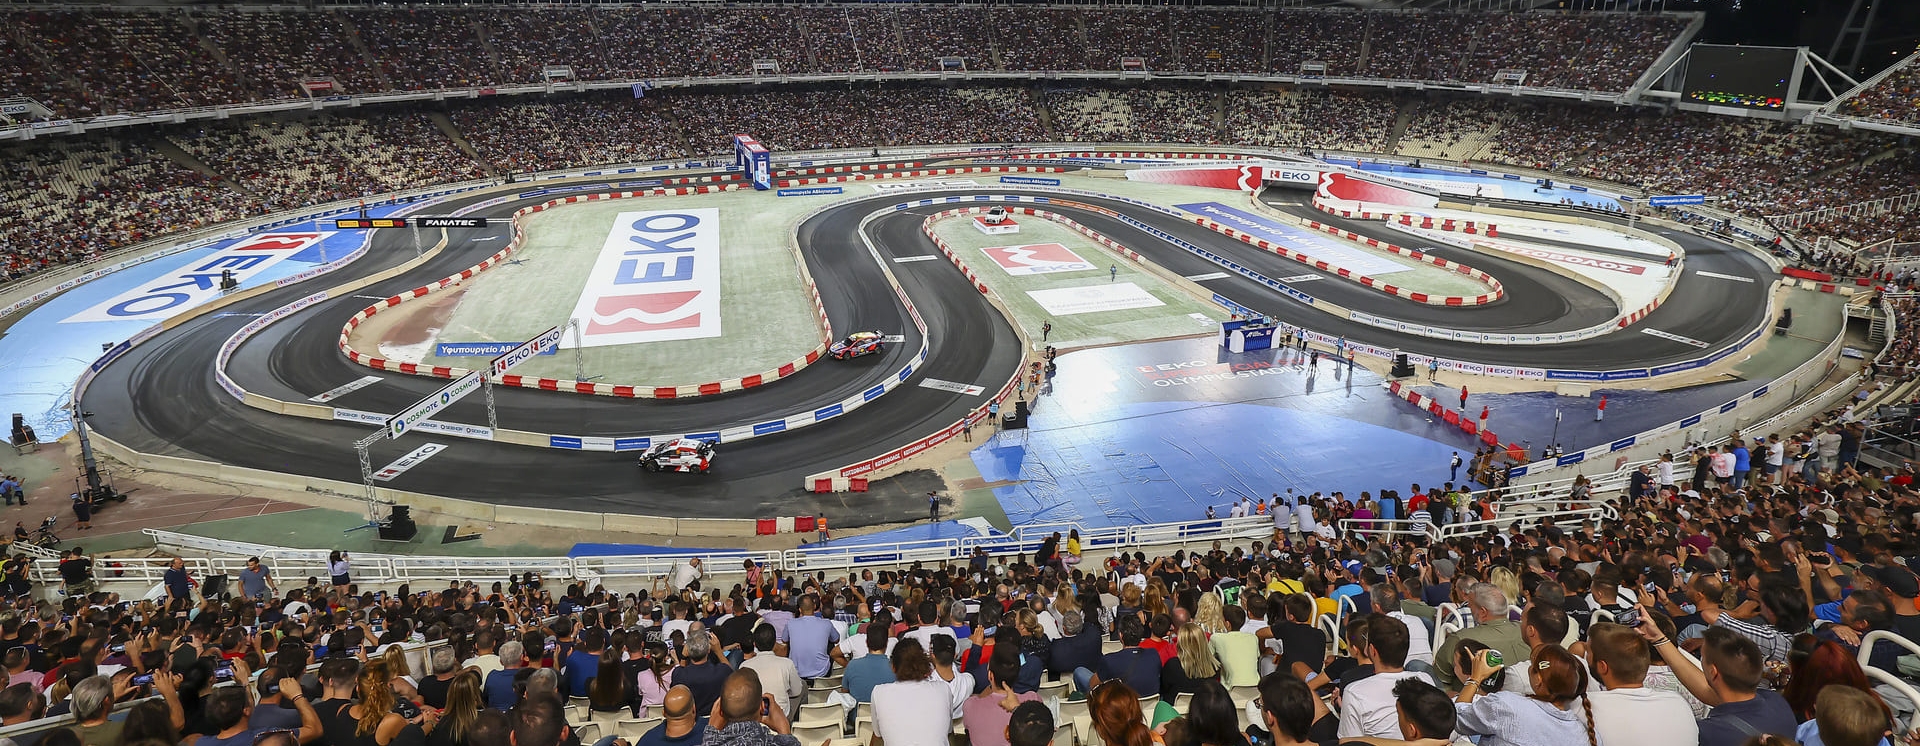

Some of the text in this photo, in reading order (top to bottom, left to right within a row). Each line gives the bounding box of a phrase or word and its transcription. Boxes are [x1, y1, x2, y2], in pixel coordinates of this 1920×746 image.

[1282, 172, 1310, 181] EKO
[614, 214, 700, 285] EKO
[1030, 264, 1087, 272] EKO
[38, 291, 48, 300] EKO
[61, 282, 73, 290] EKO
[81, 275, 92, 283] EKO
[101, 268, 112, 276] EKO
[107, 256, 273, 316] EKO
[539, 331, 560, 348] EKO
[1322, 337, 1338, 345] EKO
[1348, 344, 1364, 352] EKO
[441, 345, 498, 355] Υφυπουργείο
[507, 348, 530, 367] EKO
[1156, 361, 1207, 371] EKO
[451, 376, 480, 397] COSMOTE
[1154, 372, 1236, 387] OLYMPIC
[406, 401, 438, 424] COSMOTE
[397, 446, 436, 466] EKO
